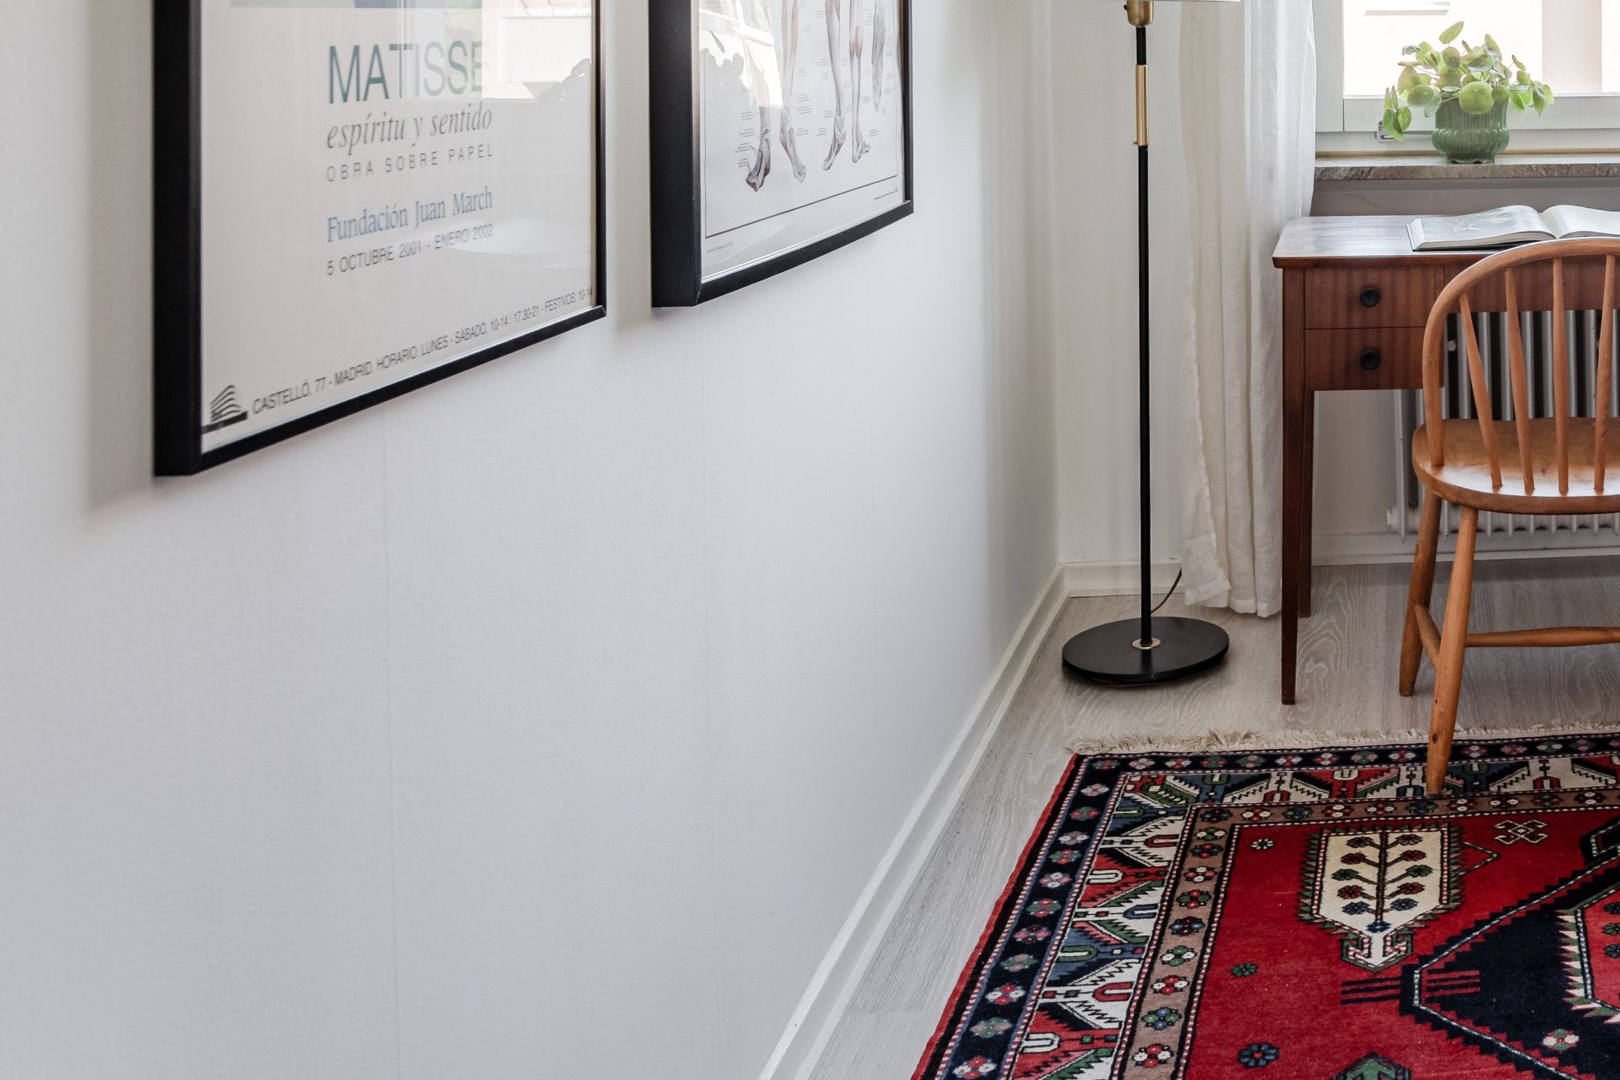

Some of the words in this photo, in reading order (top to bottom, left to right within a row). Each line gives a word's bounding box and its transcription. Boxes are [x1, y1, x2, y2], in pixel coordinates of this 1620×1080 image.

[329, 40, 486, 104] MATISSE
[327, 112, 405, 156] espíritu
[412, 117, 423, 147] y
[430, 101, 493, 137] sentido
[327, 161, 374, 182] OBRA
[385, 151, 439, 173] SOBRE
[449, 143, 494, 164] PAPEL
[327, 204, 408, 243] Fundación
[415, 199, 446, 231] Juan
[452, 186, 494, 216] March
[327, 260, 335, 276] 5
[339, 245, 395, 273] OCTUBRE
[399, 241, 423, 258] 2001
[434, 228, 469, 250] ENERO
[315, 377, 327, 394] 77
[421, 335, 449, 357] LUNES
